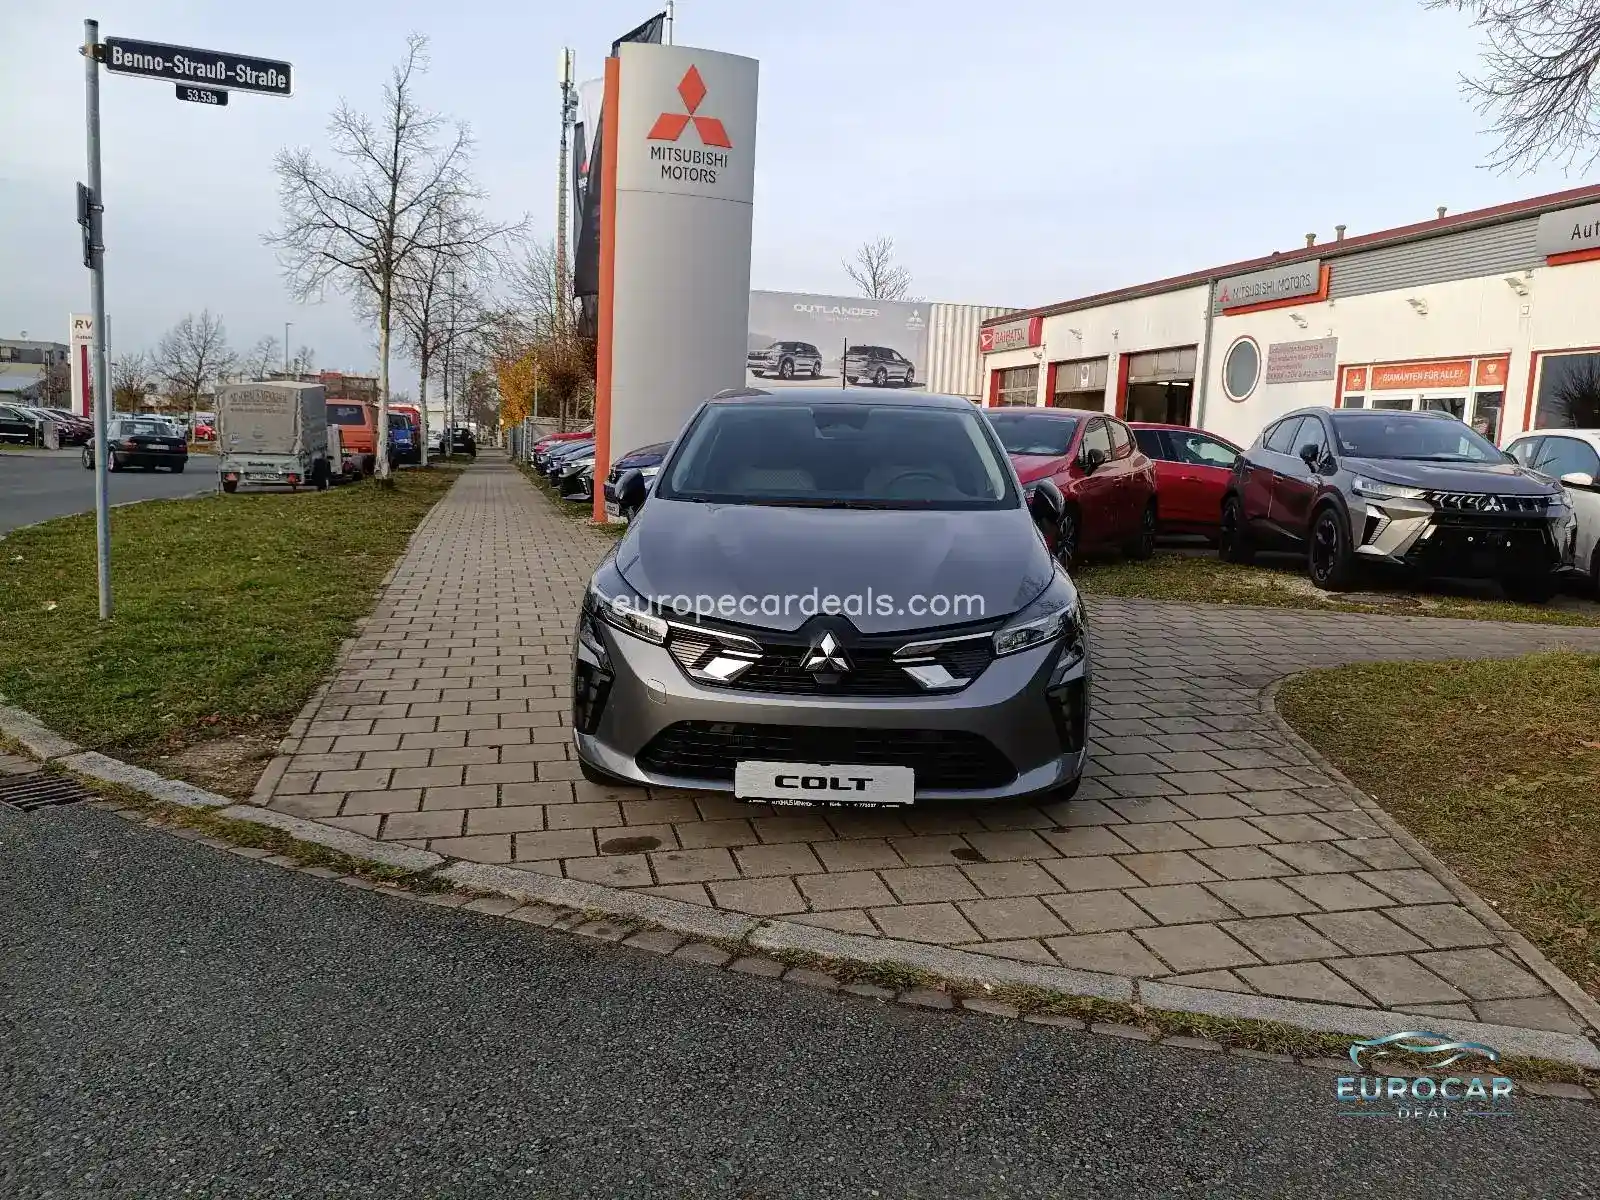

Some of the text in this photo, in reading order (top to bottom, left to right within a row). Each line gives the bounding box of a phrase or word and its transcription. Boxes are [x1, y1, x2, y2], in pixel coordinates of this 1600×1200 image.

[112, 46, 287, 88] Benno-Strauß-Straße
[650, 146, 728, 168] MITSUBISHI
[661, 165, 716, 184] MOTORS
[1233, 273, 1311, 298] MITSUBISHI MOTORS
[793, 303, 880, 316] OUTLANDER
[1382, 369, 1464, 382] DIAMANTEN FÜR ALLE!
[774, 775, 874, 791] COLT
